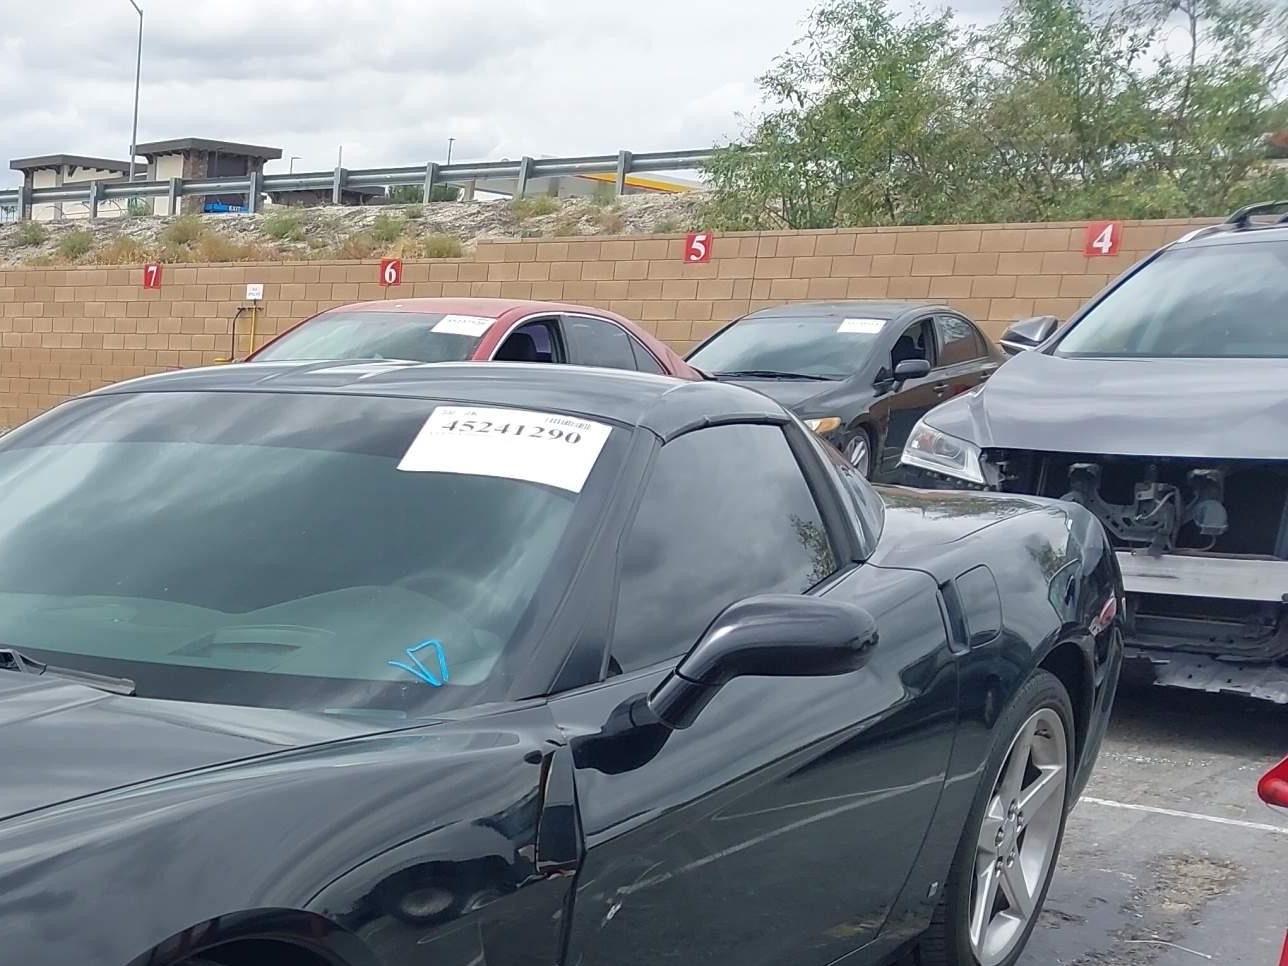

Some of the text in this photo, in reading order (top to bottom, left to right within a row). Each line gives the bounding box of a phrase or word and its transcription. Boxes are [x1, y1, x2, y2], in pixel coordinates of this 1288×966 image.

[689, 234, 707, 261] 5
[1092, 224, 1114, 254] 4
[148, 266, 158, 287] 7
[384, 260, 397, 285] 6
[441, 420, 582, 444] 45241290
